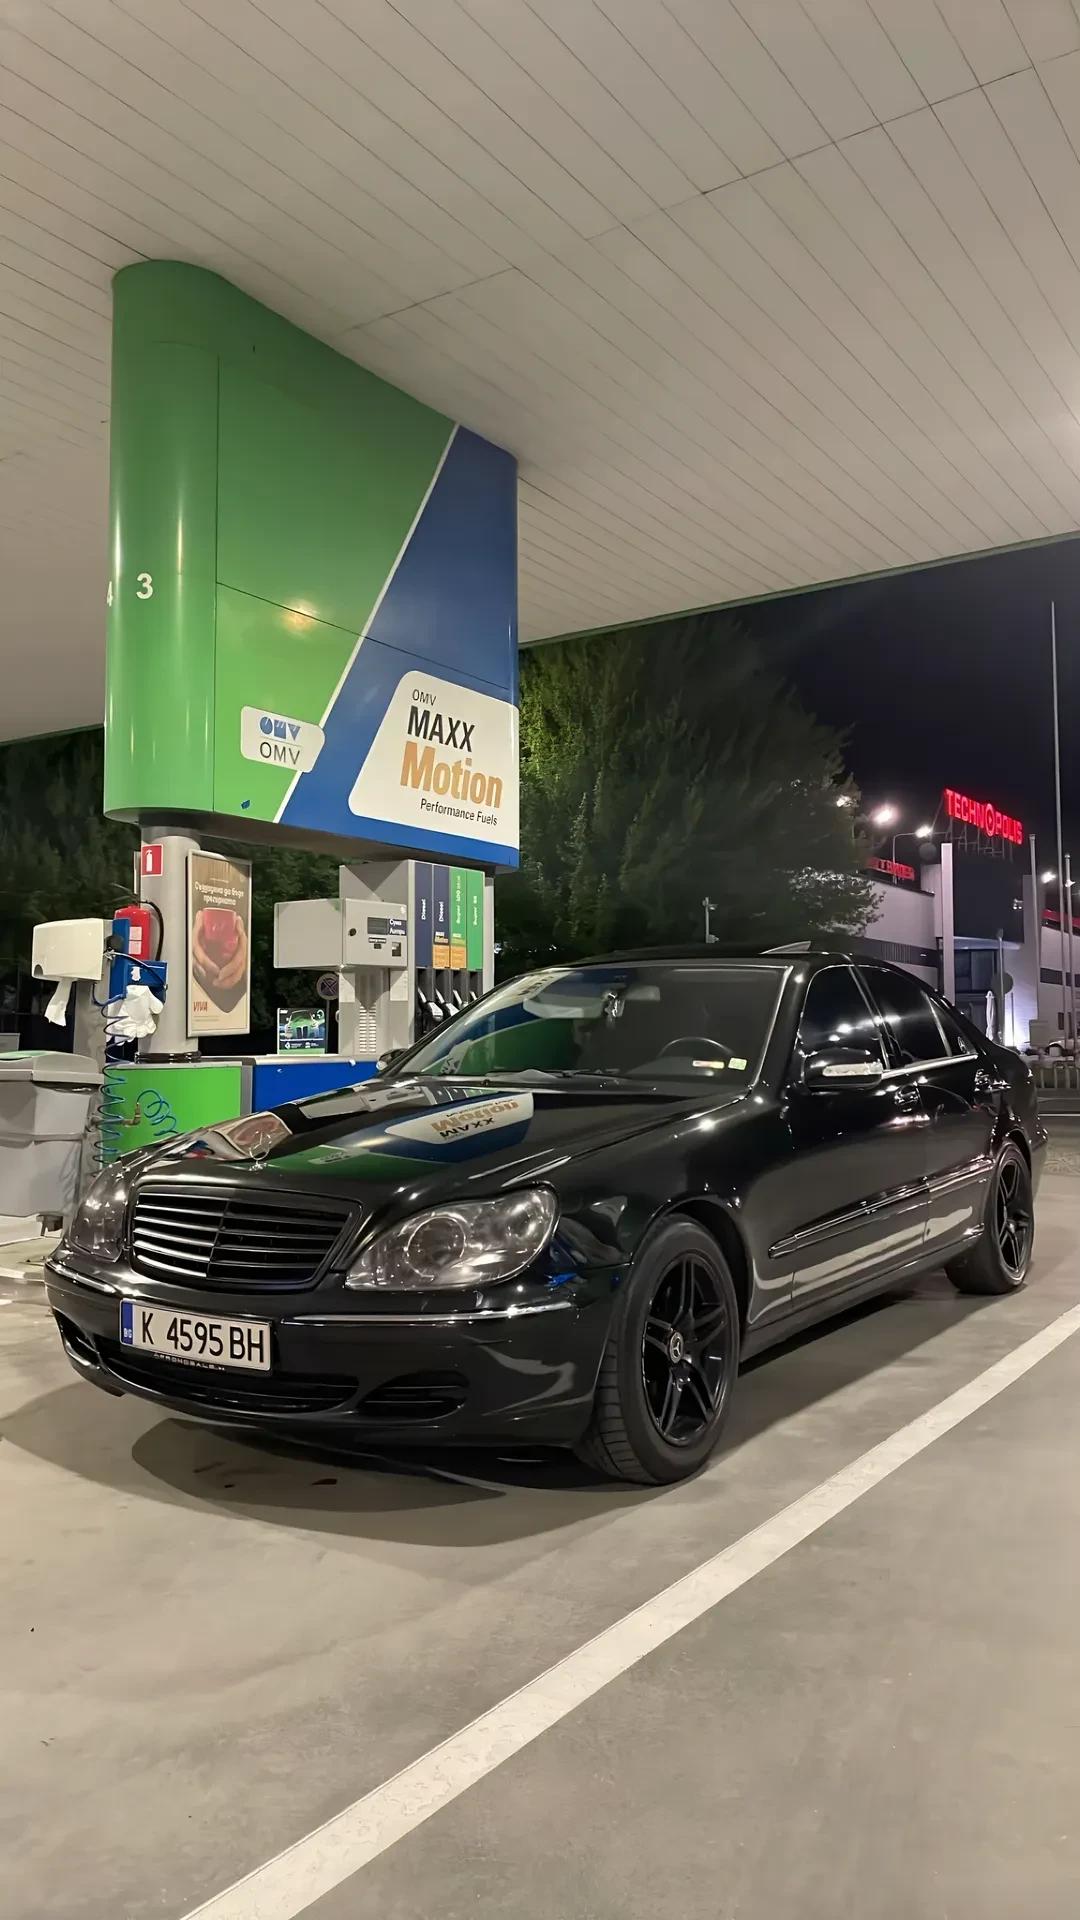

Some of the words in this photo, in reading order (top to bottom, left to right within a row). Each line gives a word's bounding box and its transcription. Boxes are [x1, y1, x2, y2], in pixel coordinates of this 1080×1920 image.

[136, 572, 154, 600] 3
[412, 689, 437, 706] OMV
[407, 705, 475, 752] MAXX
[260, 741, 301, 765] OMV
[400, 740, 503, 808] Motion
[420, 798, 475, 821] Performance
[476, 811, 498, 826] Fuels
[945, 788, 1023, 844] TECHNOPOLIS
[193, 1001, 208, 1012] VIVA
[123, 1327, 133, 1339] BG
[142, 1311, 154, 1345] K
[166, 1317, 224, 1357] 4595
[229, 1326, 264, 1363] BH
